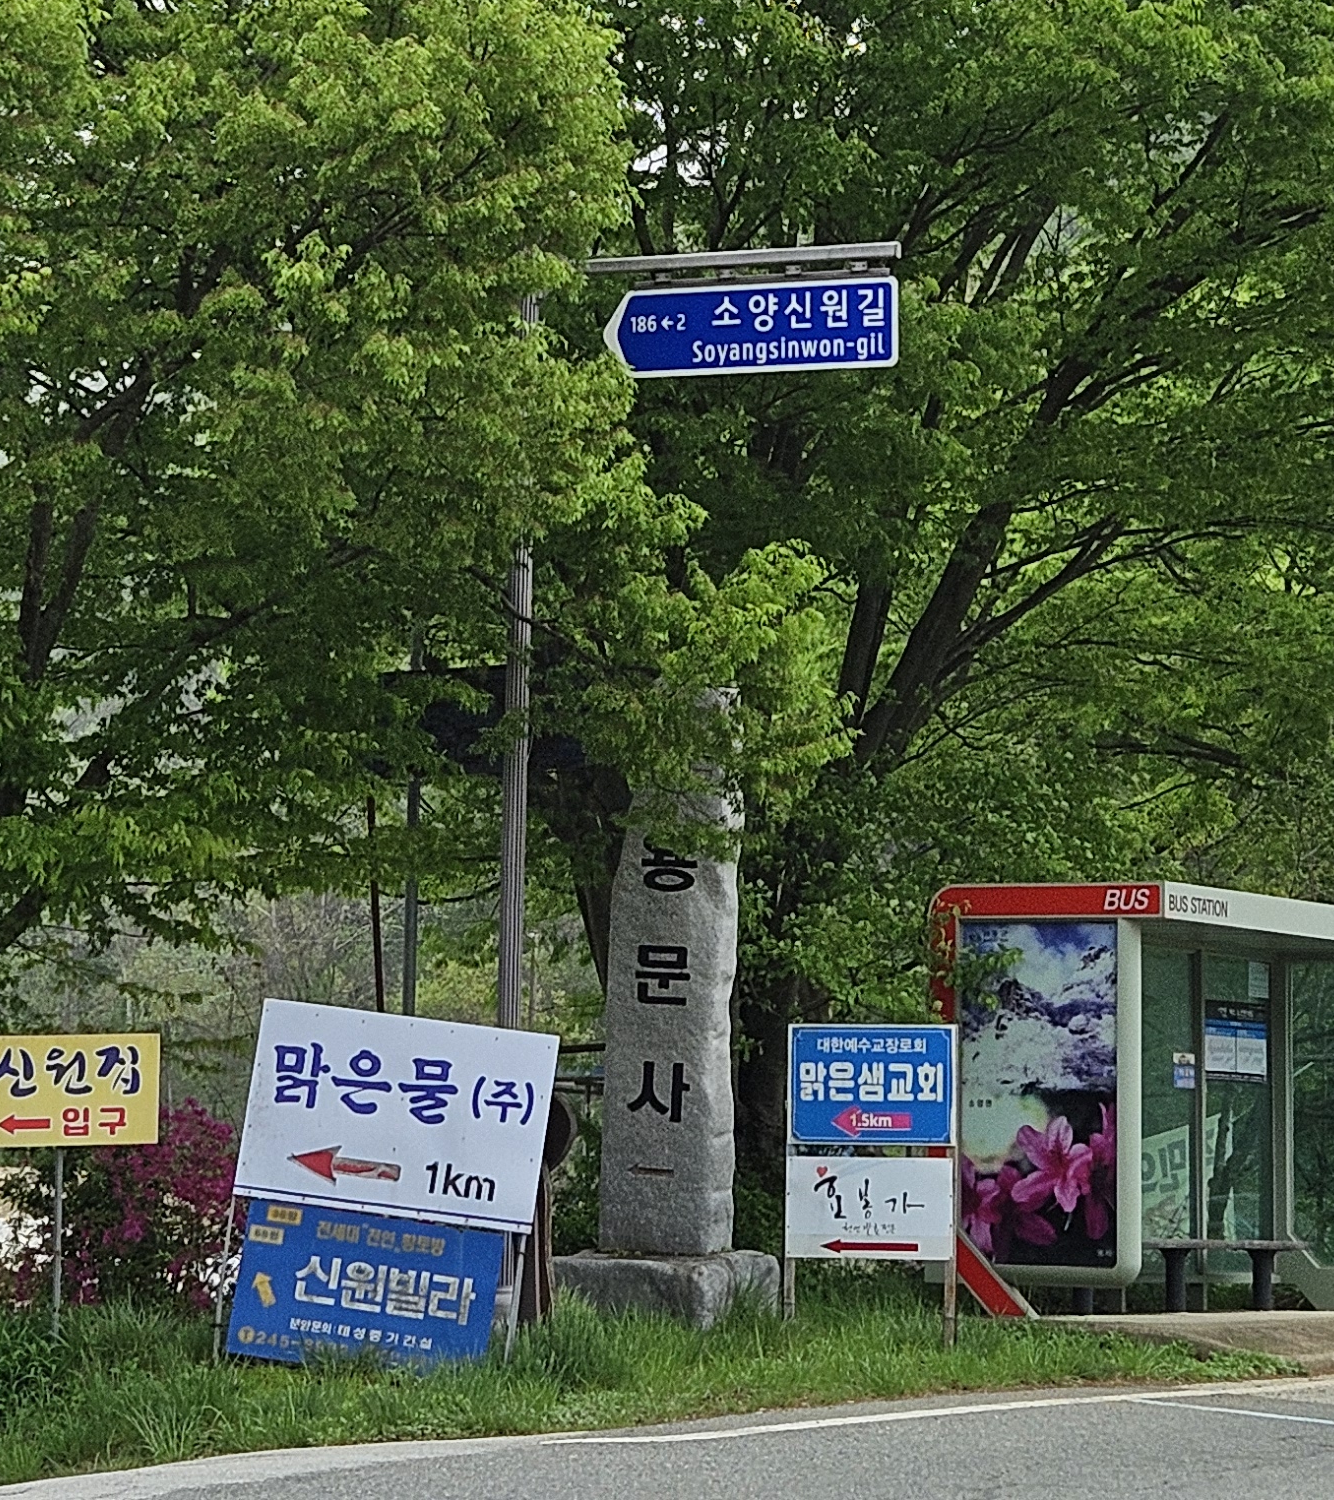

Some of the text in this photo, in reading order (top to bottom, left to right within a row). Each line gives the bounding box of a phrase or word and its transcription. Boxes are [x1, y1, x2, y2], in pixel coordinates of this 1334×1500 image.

[629, 315, 658, 333] 186
[711, 287, 886, 333] 소양신원길
[691, 331, 886, 365] Soyangsinwon-gil
[1103, 888, 1151, 911] BUS
[1168, 893, 1229, 918] BUS STATION
[816, 1037, 927, 1054] 대한예수교장로회
[273, 1042, 535, 1126] 맑은물 (주)
[799, 1060, 944, 1102] 맑은샘교회
[61, 1106, 127, 1137] 입구
[849, 1112, 893, 1128] 1.5km
[425, 1160, 497, 1202] 1km
[813, 1174, 926, 1220] 효봉가
[294, 1254, 477, 1327] 신원빌라
